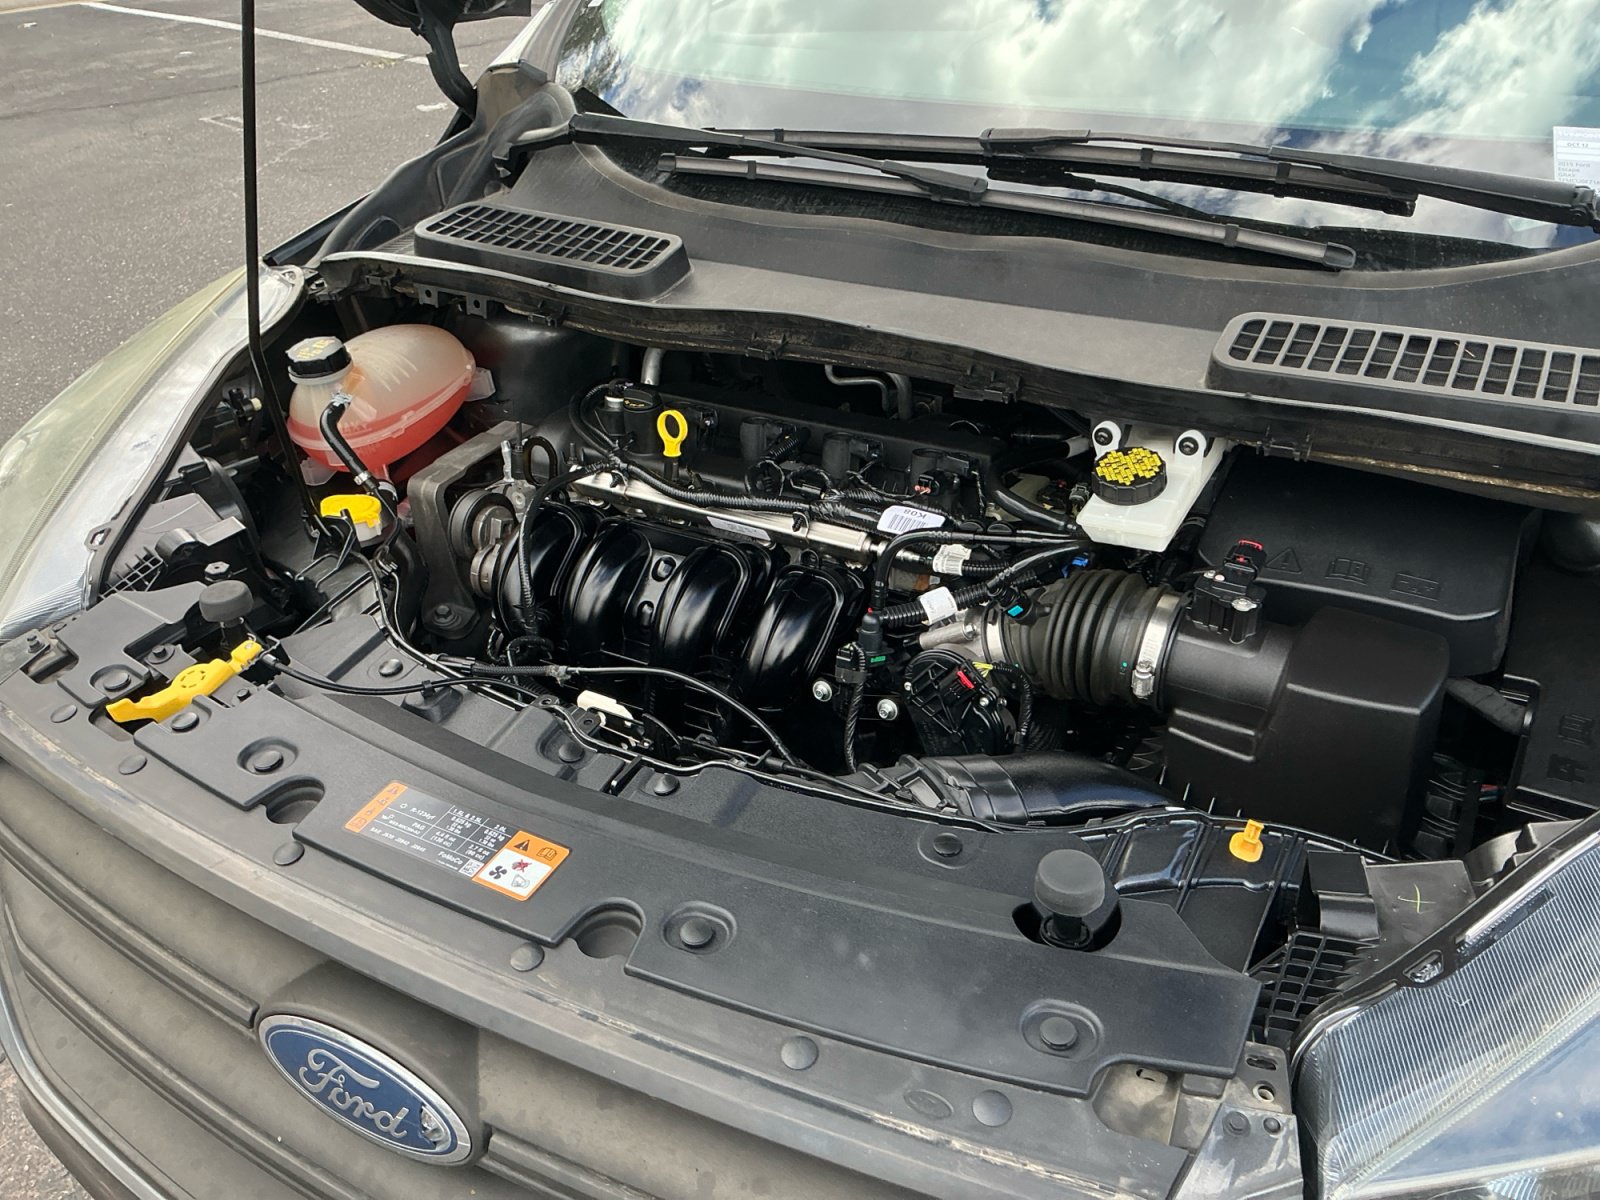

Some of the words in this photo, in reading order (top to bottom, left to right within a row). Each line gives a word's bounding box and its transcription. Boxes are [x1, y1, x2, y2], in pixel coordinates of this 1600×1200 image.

[904, 509, 928, 518] K08
[410, 807, 436, 819] R-1234yf
[412, 822, 426, 830] PAG
[438, 851, 463, 864] FoMoCo
[298, 1048, 410, 1139] Ford
